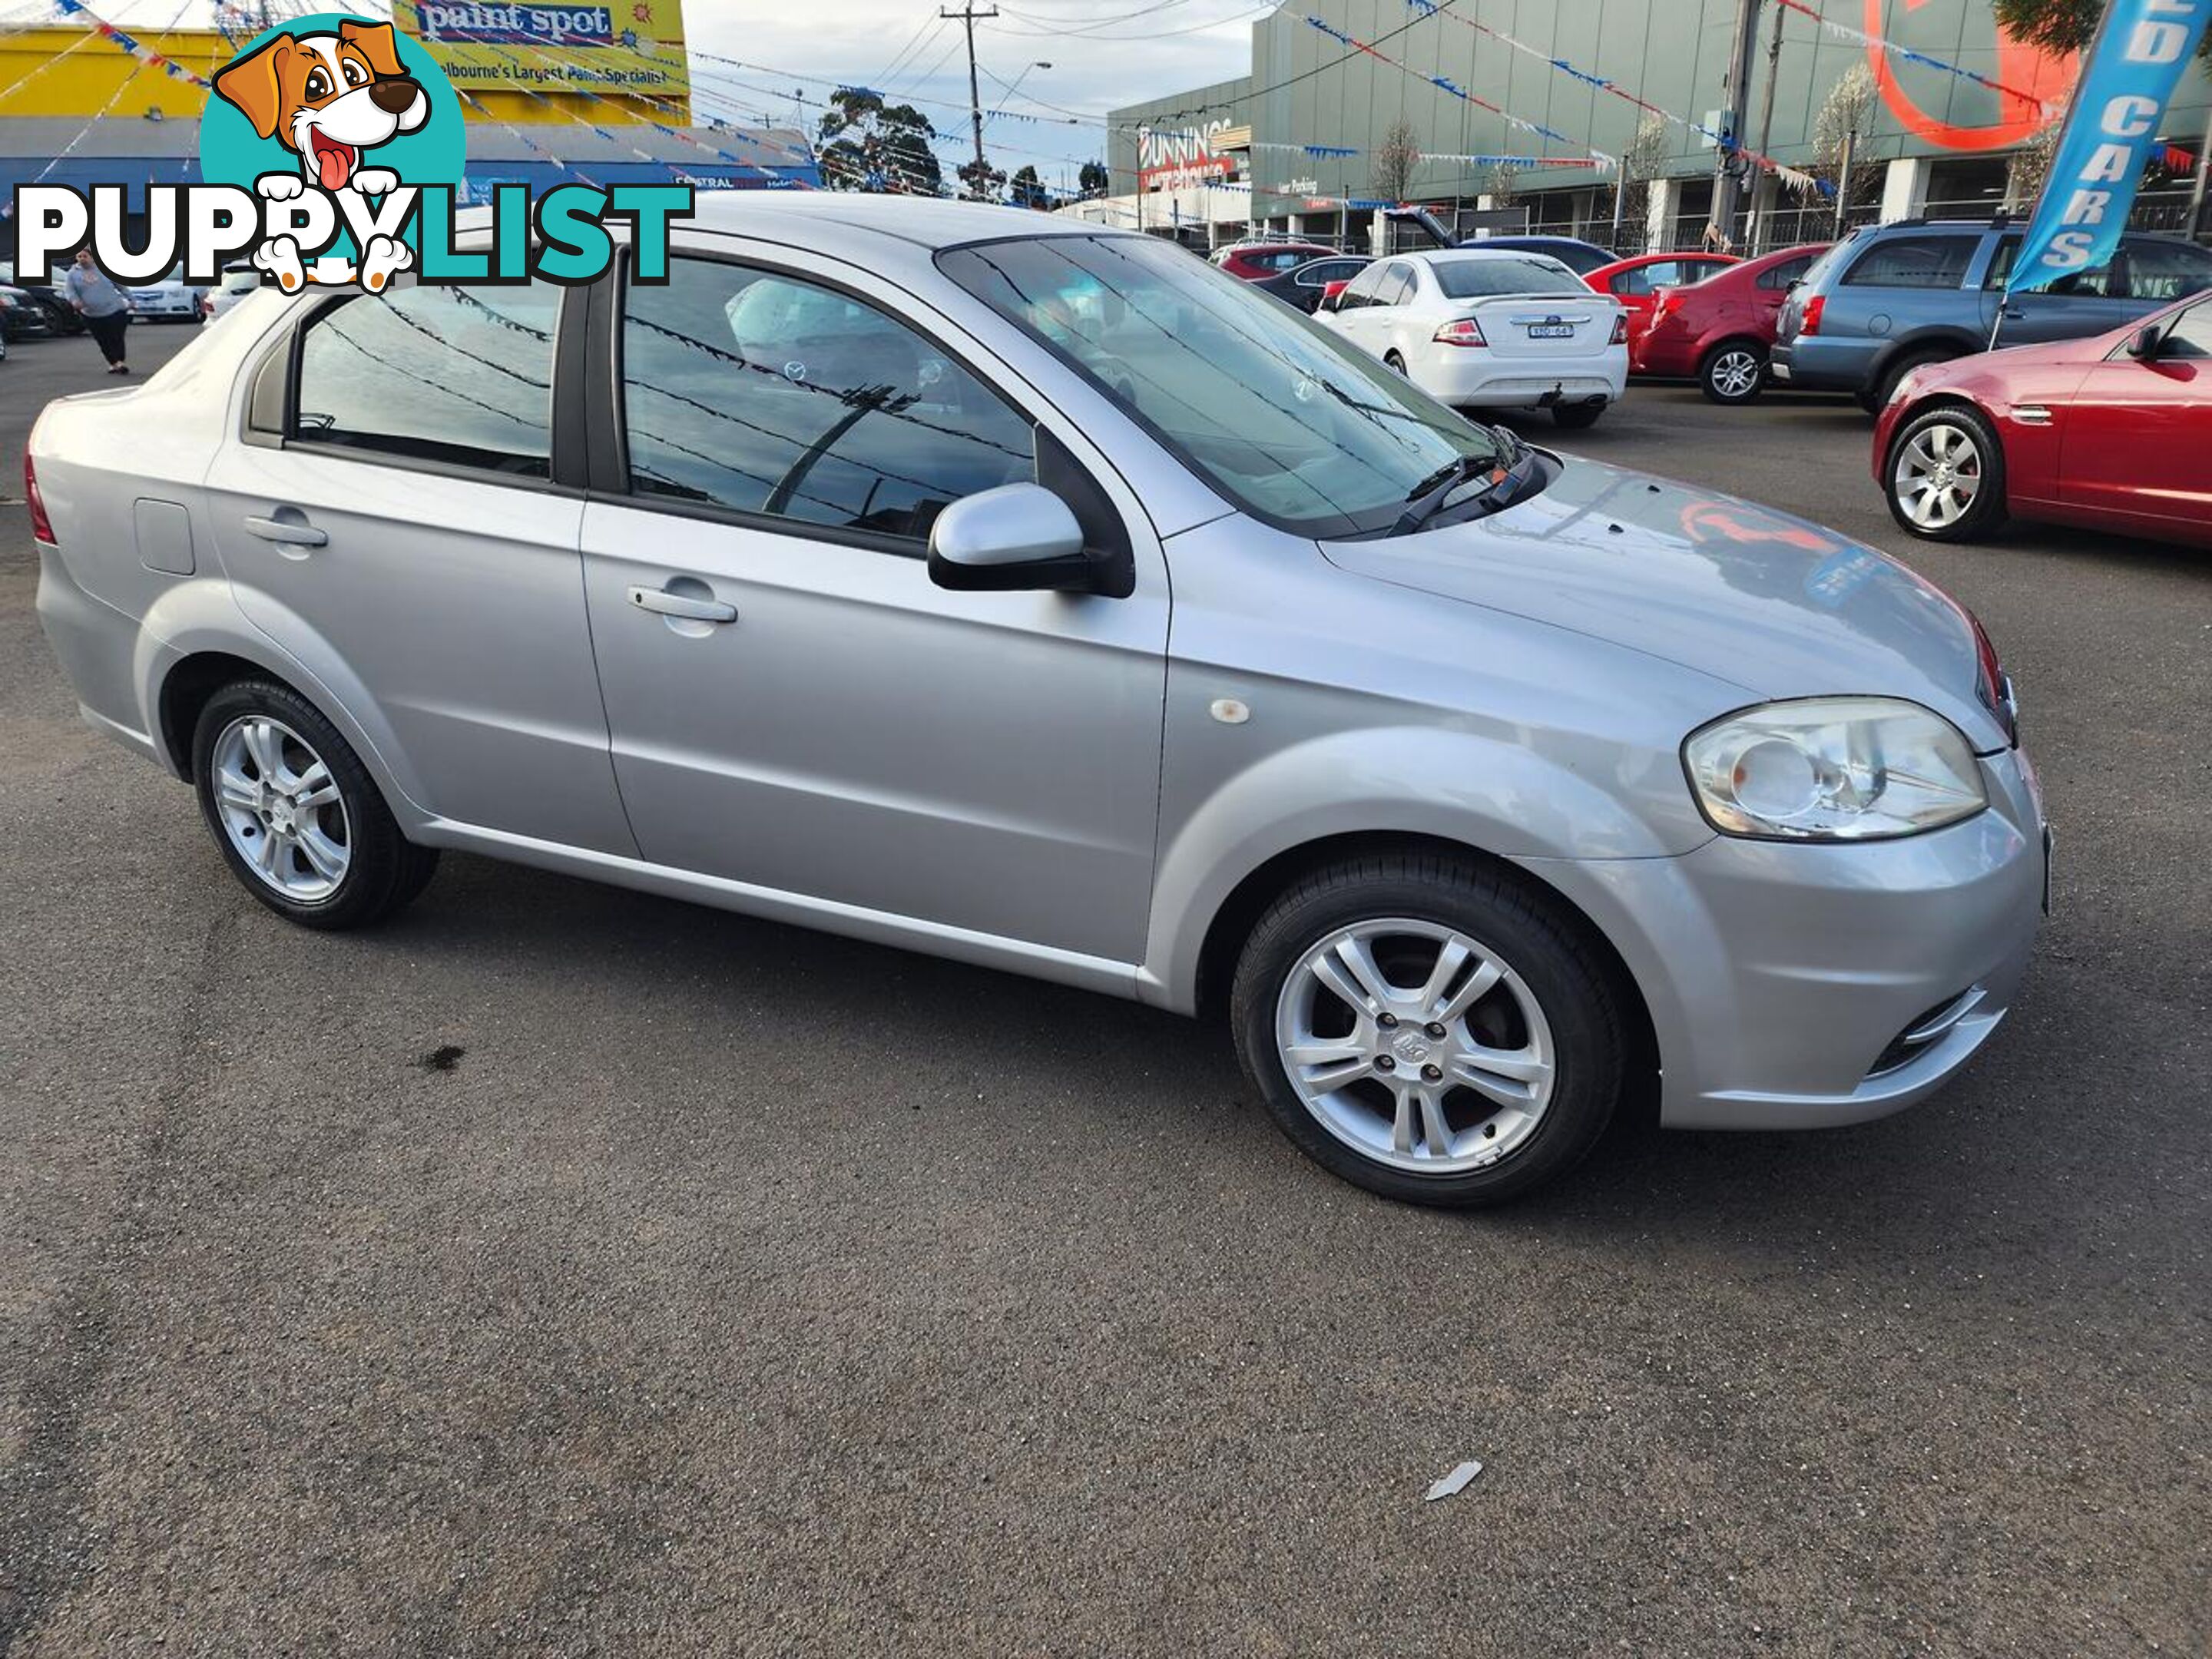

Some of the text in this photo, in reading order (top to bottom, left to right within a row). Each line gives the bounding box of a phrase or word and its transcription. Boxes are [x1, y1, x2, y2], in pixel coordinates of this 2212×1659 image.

[423, 5, 609, 40] paint spot
[441, 62, 510, 78] elbourne's
[513, 64, 563, 84] Largest
[2040, 95, 2159, 269] CARS
